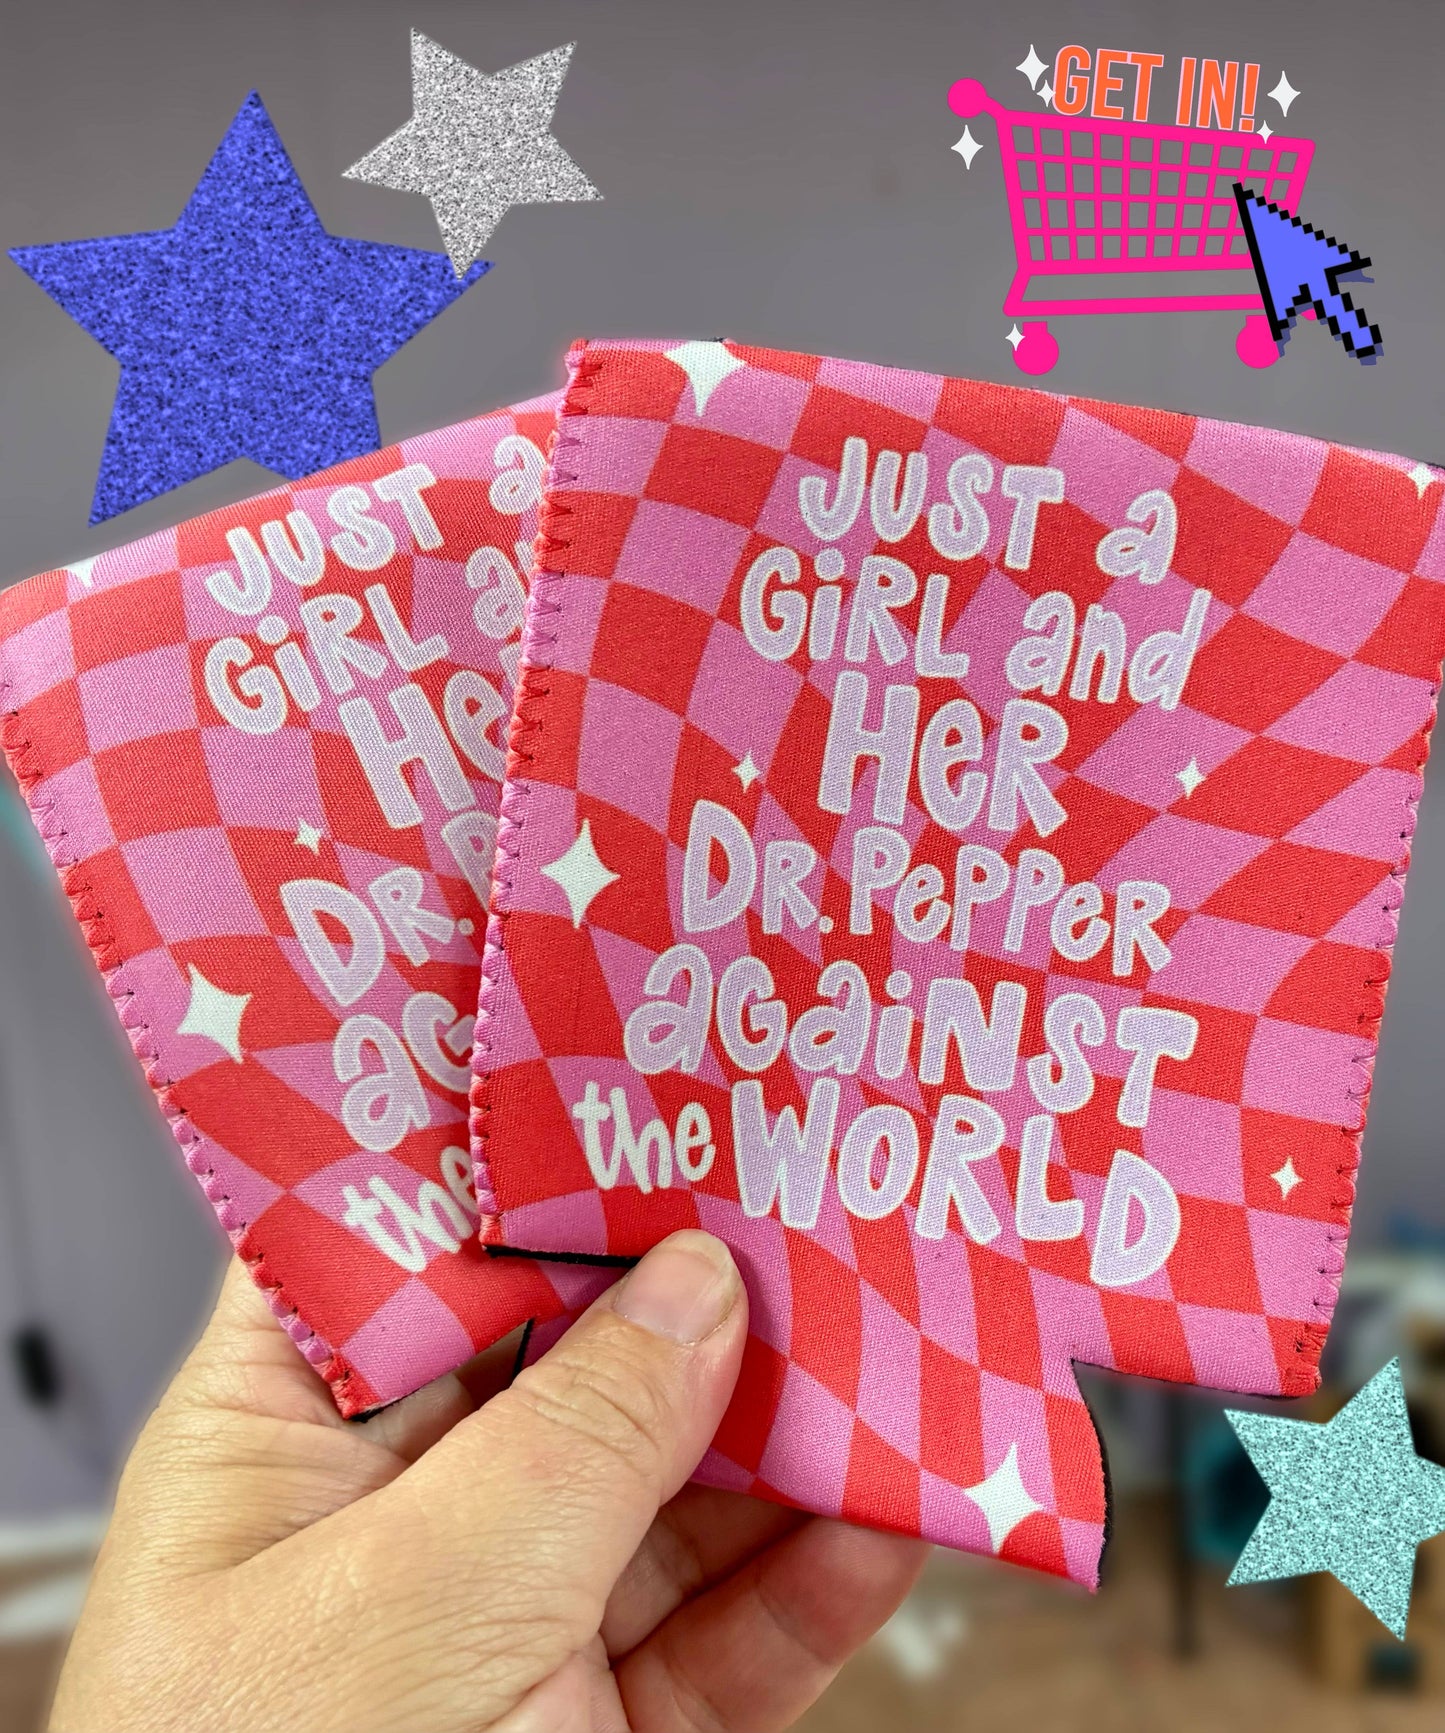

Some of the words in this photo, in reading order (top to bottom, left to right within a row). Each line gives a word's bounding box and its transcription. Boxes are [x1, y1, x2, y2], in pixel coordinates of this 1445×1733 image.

[205, 462, 445, 617] JUST
[799, 436, 1065, 570] JUST
[1095, 490, 1178, 585] a
[1005, 588, 1212, 711] and
[338, 643, 522, 830] He
[573, 1080, 716, 1193] the
[731, 1077, 1181, 1286] WORLD
